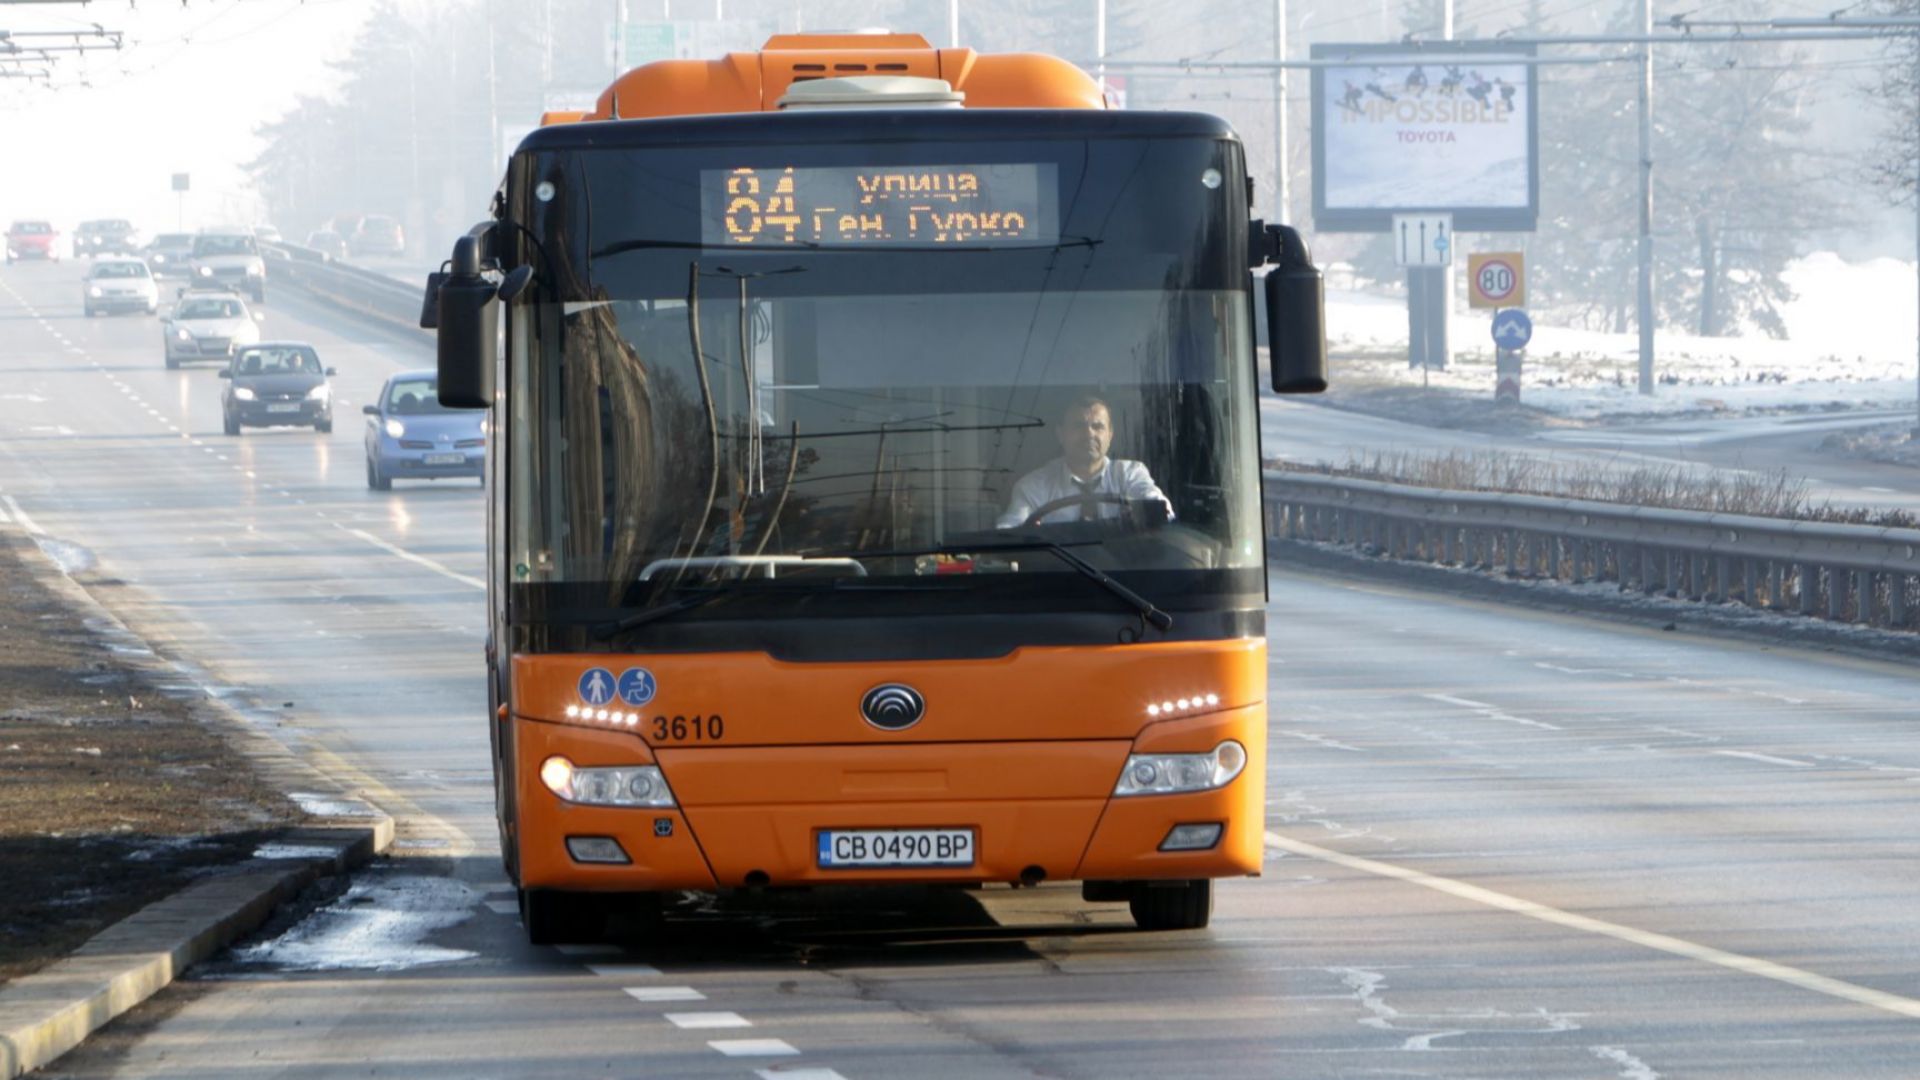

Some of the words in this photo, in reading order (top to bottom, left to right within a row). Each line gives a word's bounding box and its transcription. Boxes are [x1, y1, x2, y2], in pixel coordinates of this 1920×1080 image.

[1341, 99, 1510, 124] IMPOSSIBLE
[1396, 130, 1457, 143] TOYOTA
[857, 172, 978, 204] улица
[725, 167, 801, 242] 84
[909, 205, 1025, 241] Гурко
[1482, 268, 1511, 292] 80
[652, 714, 724, 741] 3610
[872, 835, 931, 859] 0490
